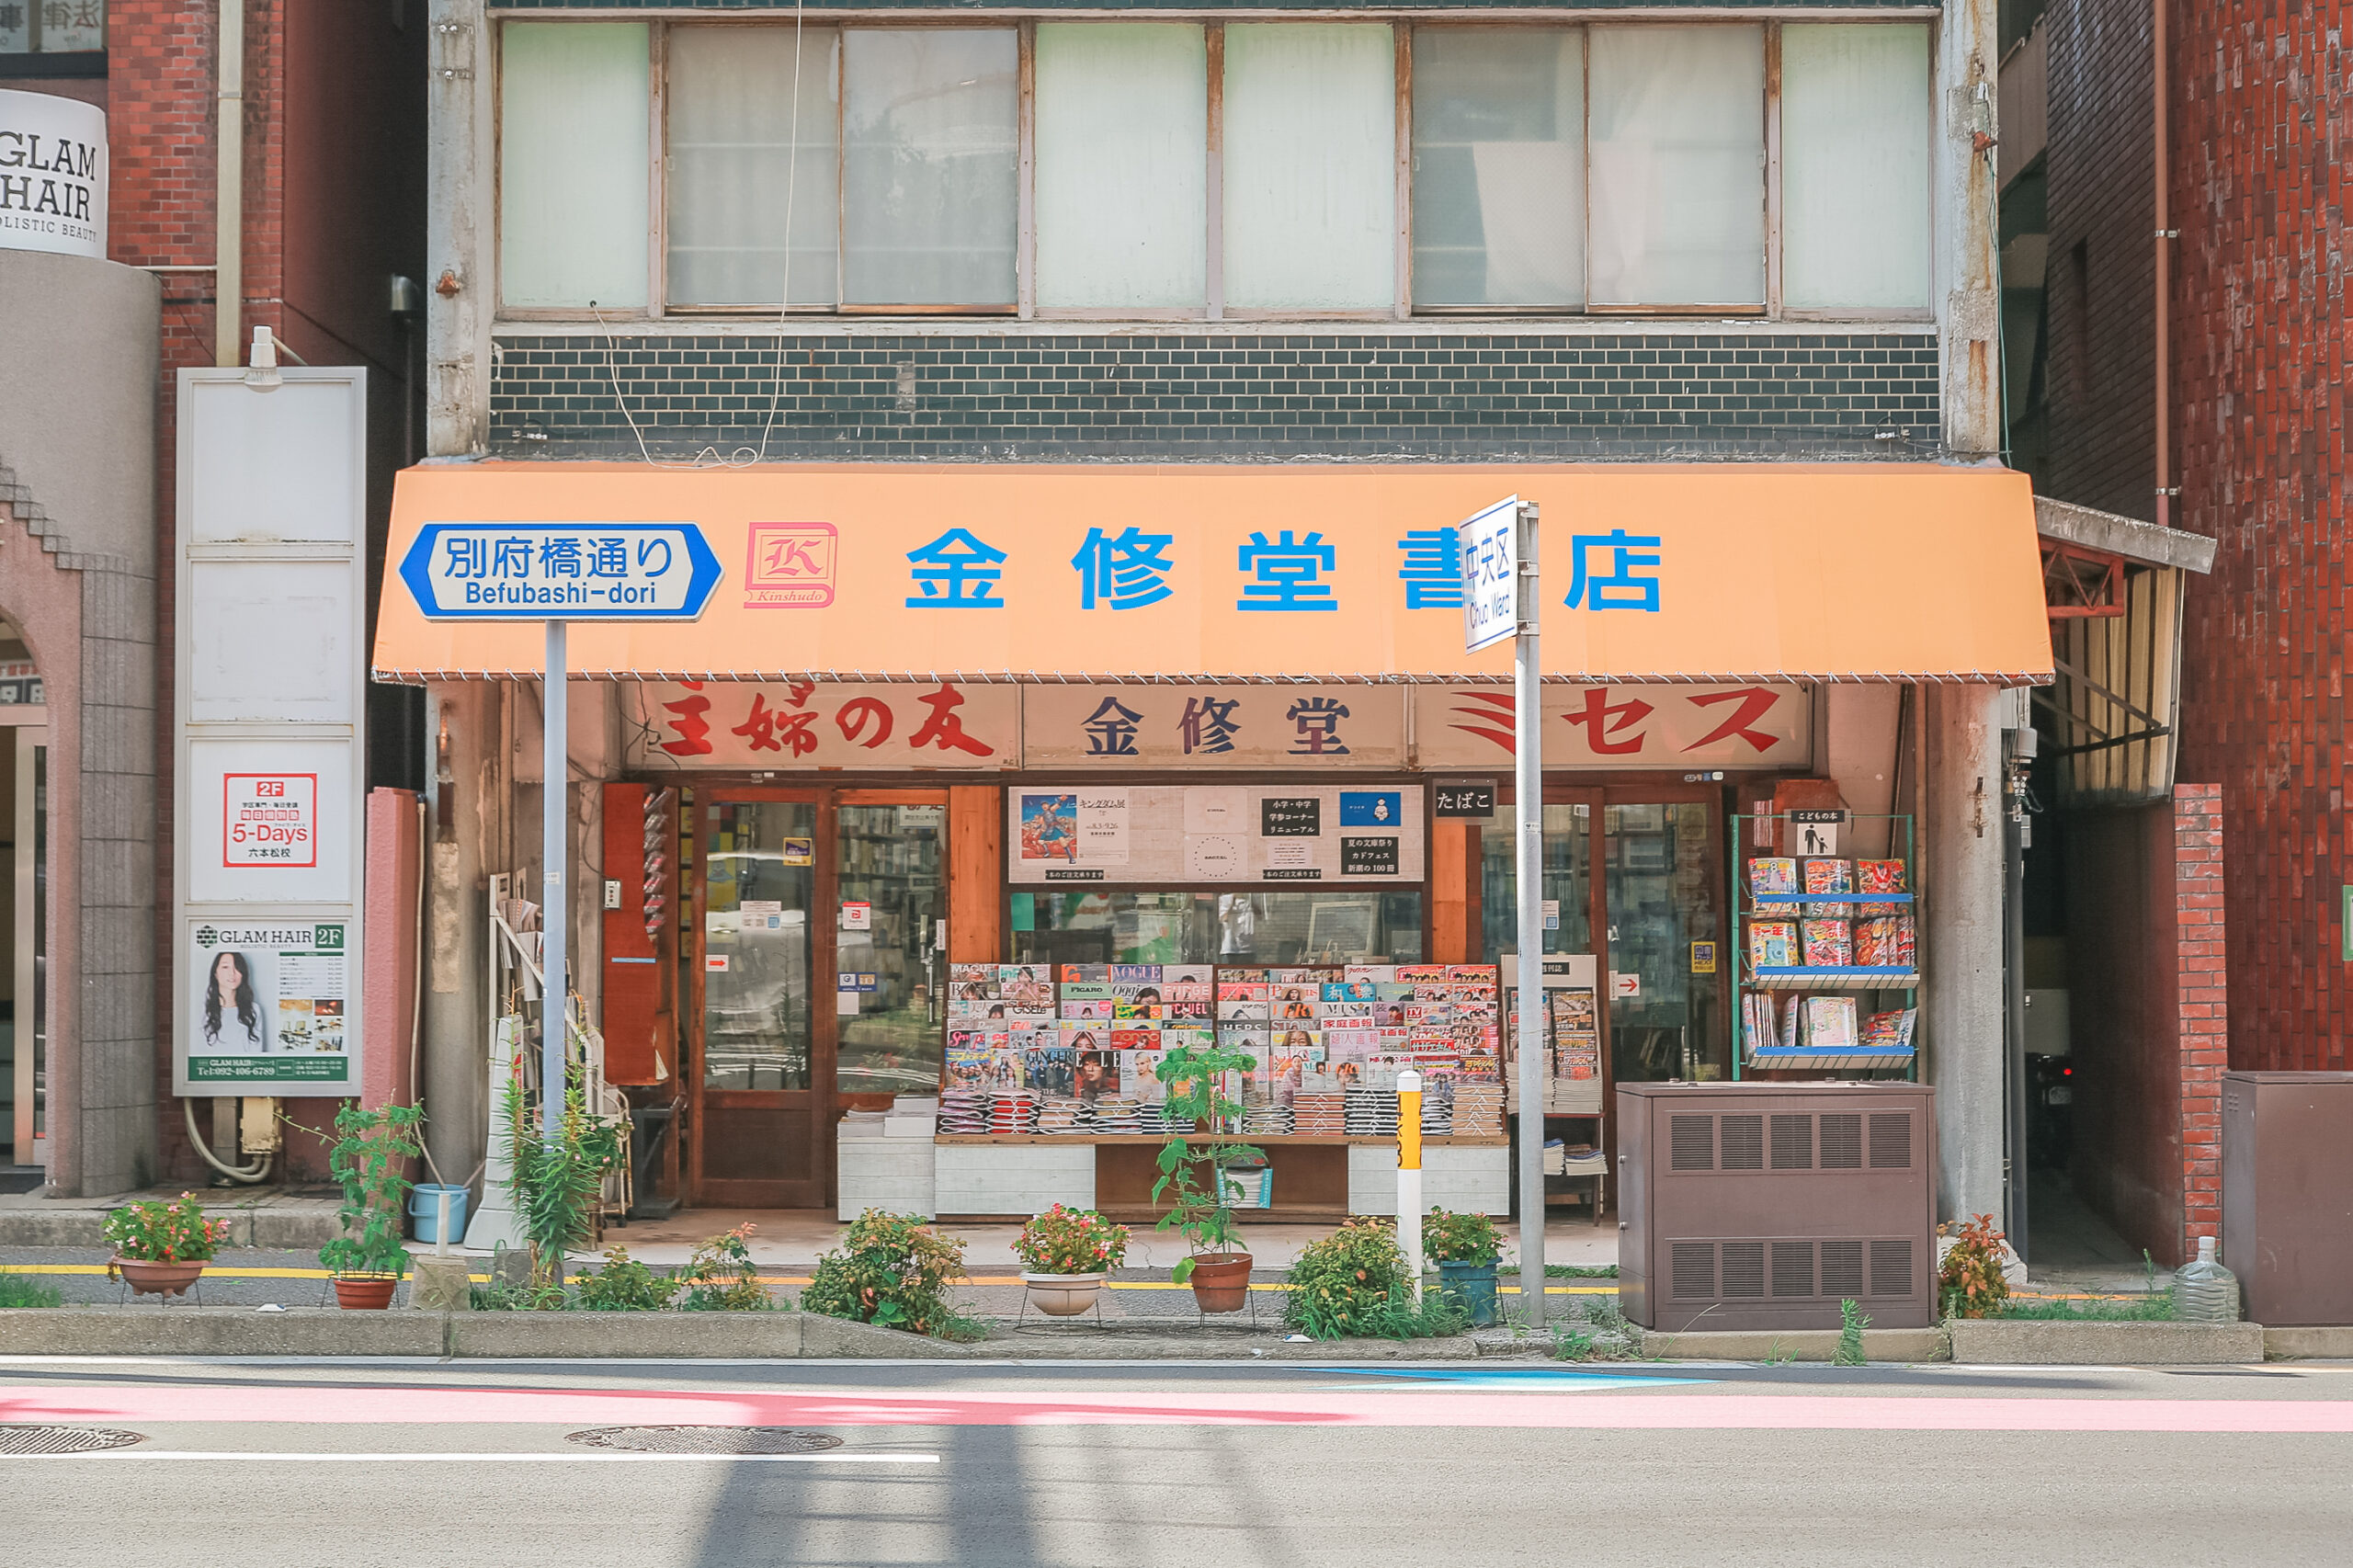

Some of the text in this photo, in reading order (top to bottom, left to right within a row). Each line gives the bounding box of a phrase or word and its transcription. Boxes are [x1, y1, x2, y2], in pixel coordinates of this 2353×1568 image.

[0, 131, 96, 181] GLAM
[0, 175, 89, 222] HAIR
[445, 537, 672, 578] 別府橋通り
[1466, 527, 1510, 602] 中央区
[905, 527, 1662, 612] 金修堂書店
[465, 582, 656, 604] Befubashi-dori
[757, 590, 824, 603] Kinshudo
[1470, 585, 1510, 630] Chuo Ward
[661, 682, 995, 758] 主婦の友
[1081, 696, 1350, 756] 金修堂
[1447, 687, 1779, 755] ミセス
[258, 783, 282, 796] 2F
[1272, 801, 1312, 809] 小学・中学
[1437, 792, 1490, 810] たばこ
[1798, 812, 1837, 821] こどもの本
[233, 824, 308, 845] 5-Days
[1270, 825, 1315, 834] リニューアル
[1347, 839, 1392, 847] 夏の文庫祭り
[248, 847, 291, 858] 六本松校
[220, 928, 342, 945] GLAM HAIR 2F
[1112, 966, 1162, 979] VOGUE
[1542, 964, 1563, 972] 刊誌
[1112, 984, 1141, 996] Oggi
[1026, 1051, 1074, 1062] GINGER
